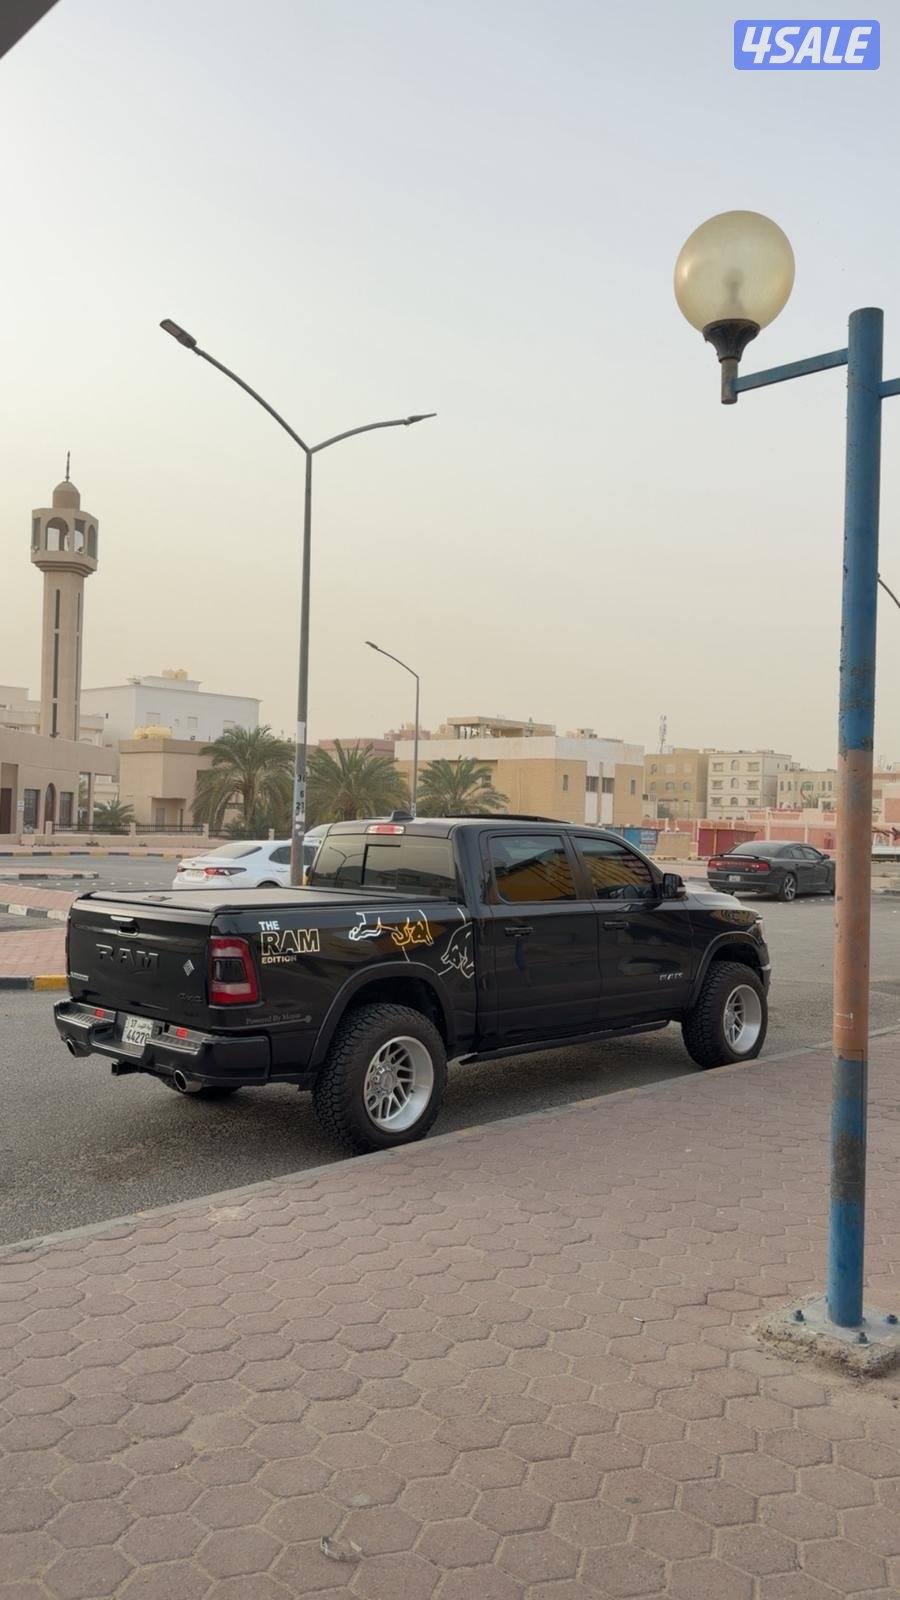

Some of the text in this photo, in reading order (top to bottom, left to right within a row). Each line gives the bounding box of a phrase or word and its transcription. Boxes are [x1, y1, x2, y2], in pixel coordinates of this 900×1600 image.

[258, 920, 280, 930] THE
[261, 928, 320, 955] RAM
[95, 943, 159, 968] RAM
[261, 954, 297, 964] EDITION
